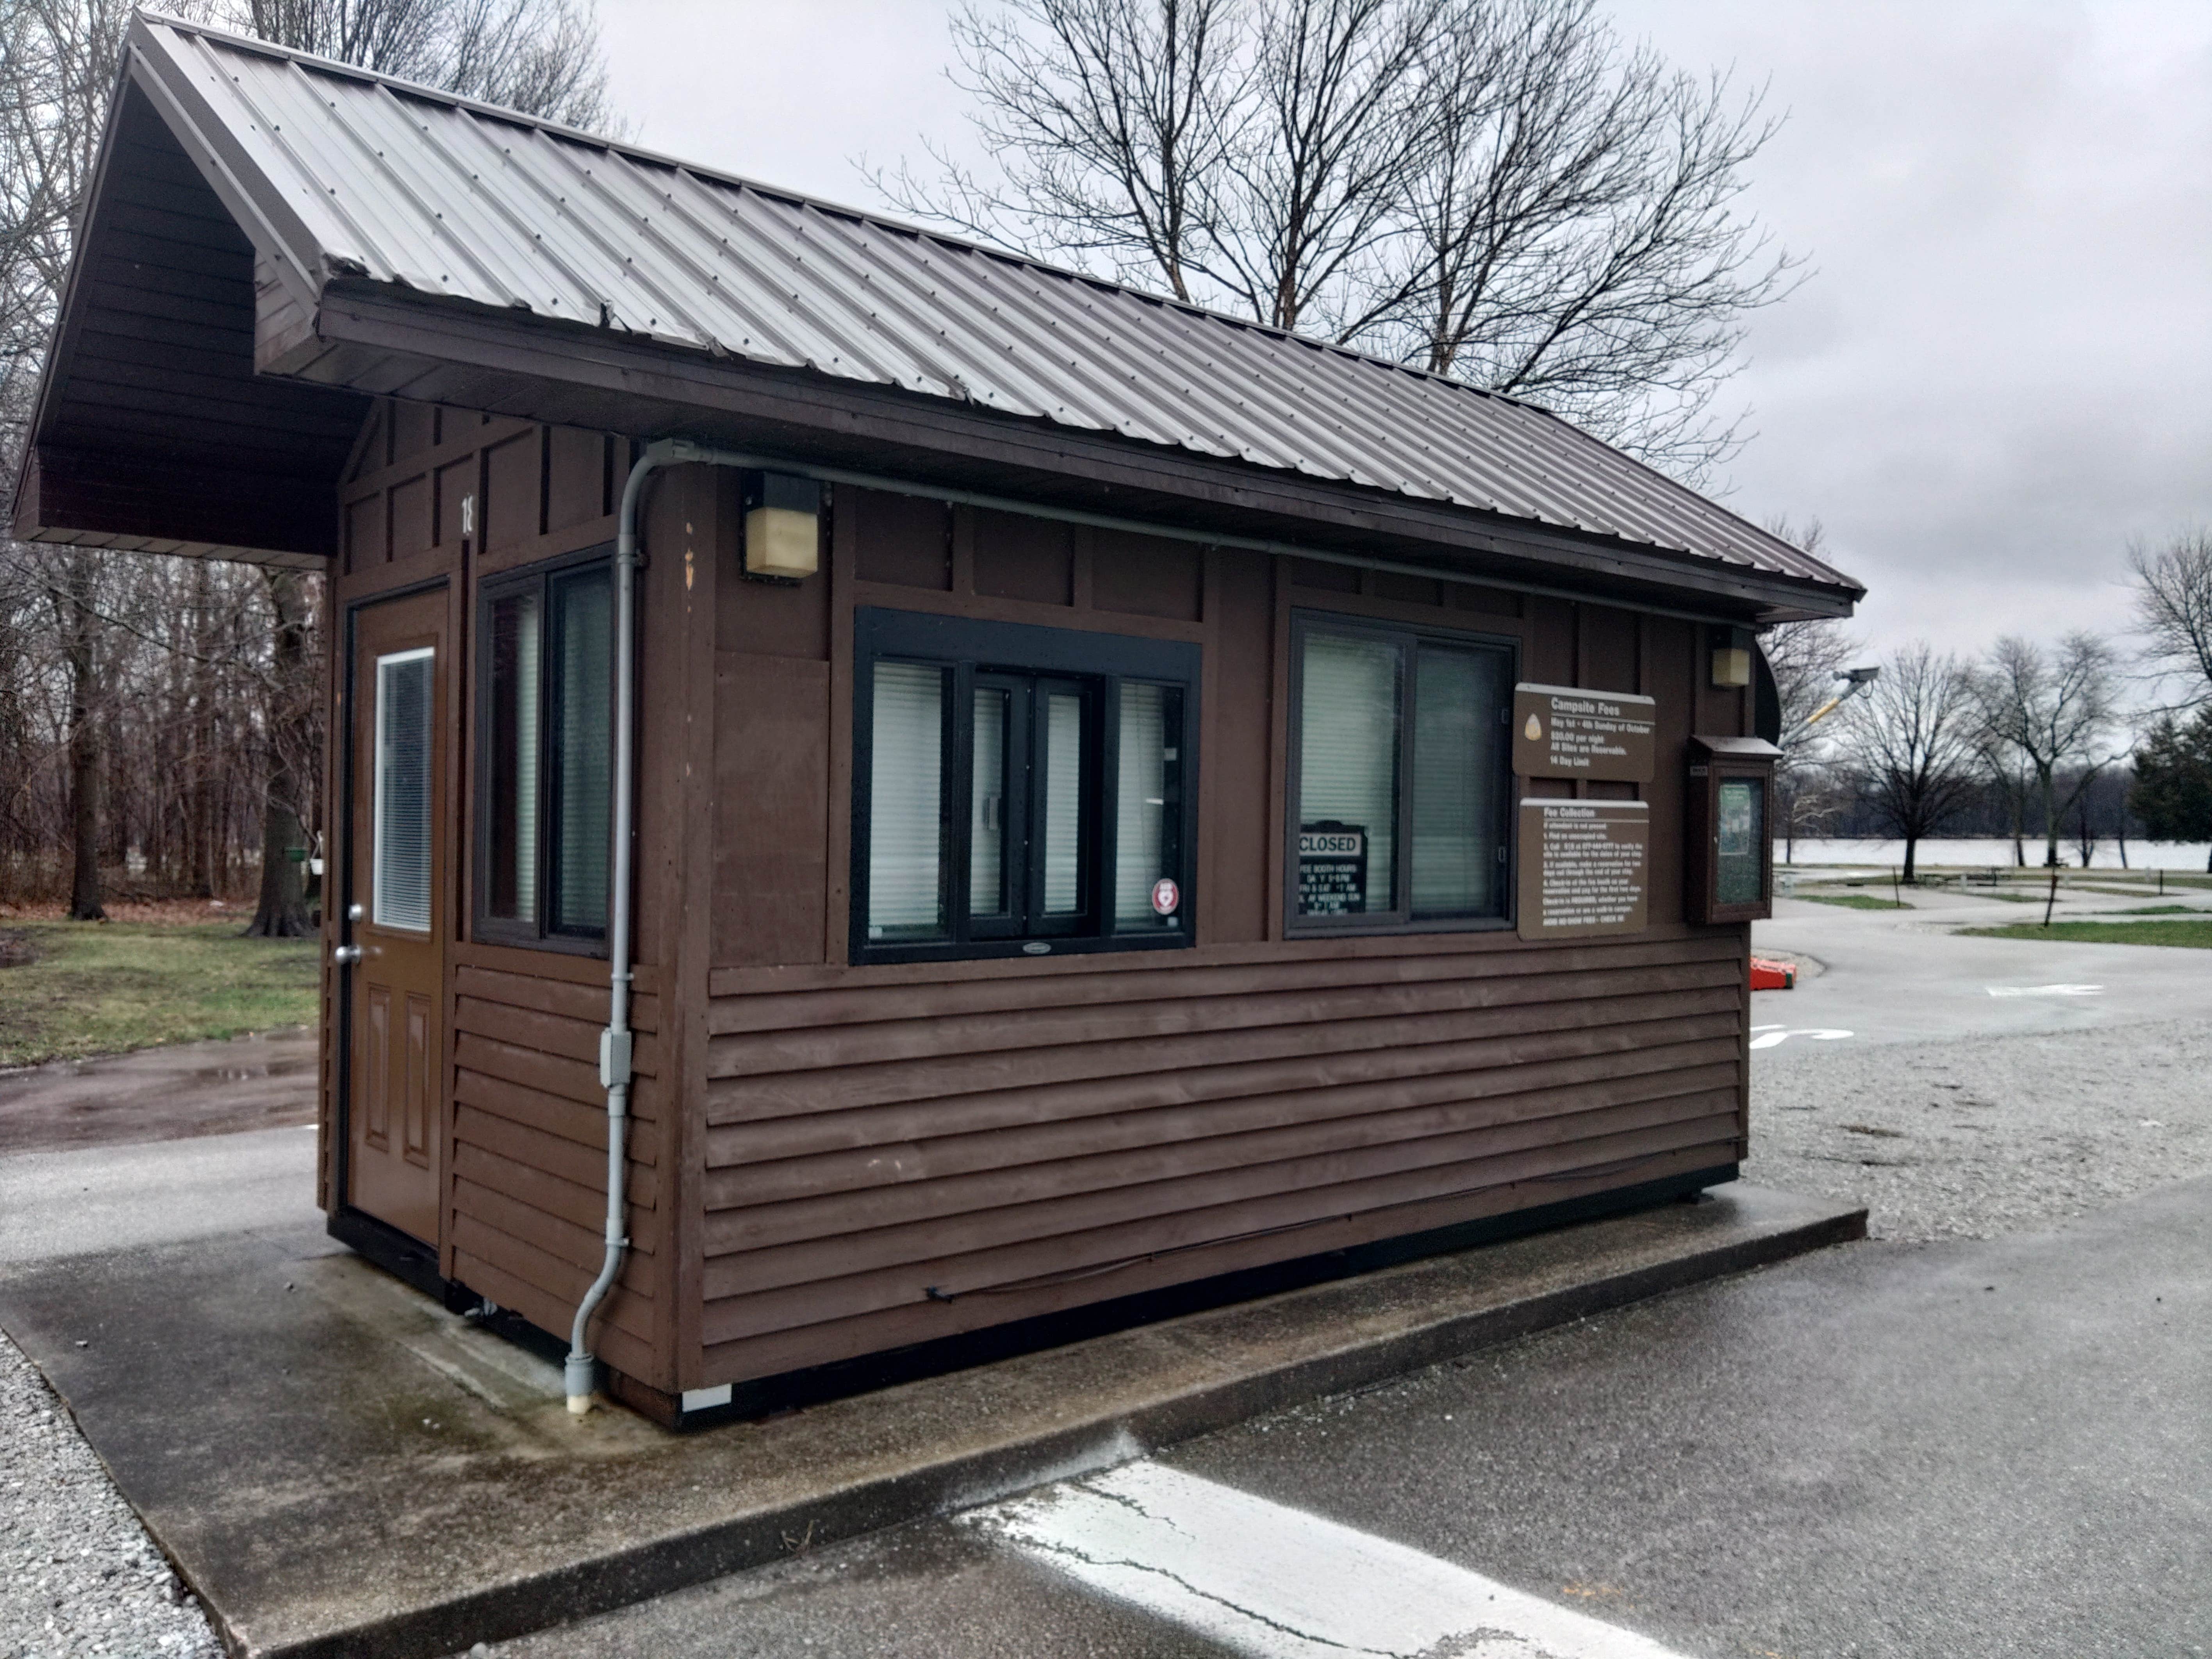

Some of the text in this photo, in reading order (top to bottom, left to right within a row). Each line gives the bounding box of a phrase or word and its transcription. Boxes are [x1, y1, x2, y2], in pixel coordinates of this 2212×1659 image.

[1551, 697, 1620, 715] Campsite Fees
[1551, 717, 1564, 728] May
[1595, 721, 1616, 732] Sunday
[1618, 723, 1625, 731] of
[1627, 724, 1650, 733] October
[1576, 735, 1587, 743] per
[1588, 735, 1604, 744] night
[1550, 742, 1560, 750] All
[1559, 756, 1572, 767] Day
[1573, 756, 1589, 766] Limit
[1544, 807, 1595, 818] Fee Collection
[1300, 837, 1356, 851] CLOSED
